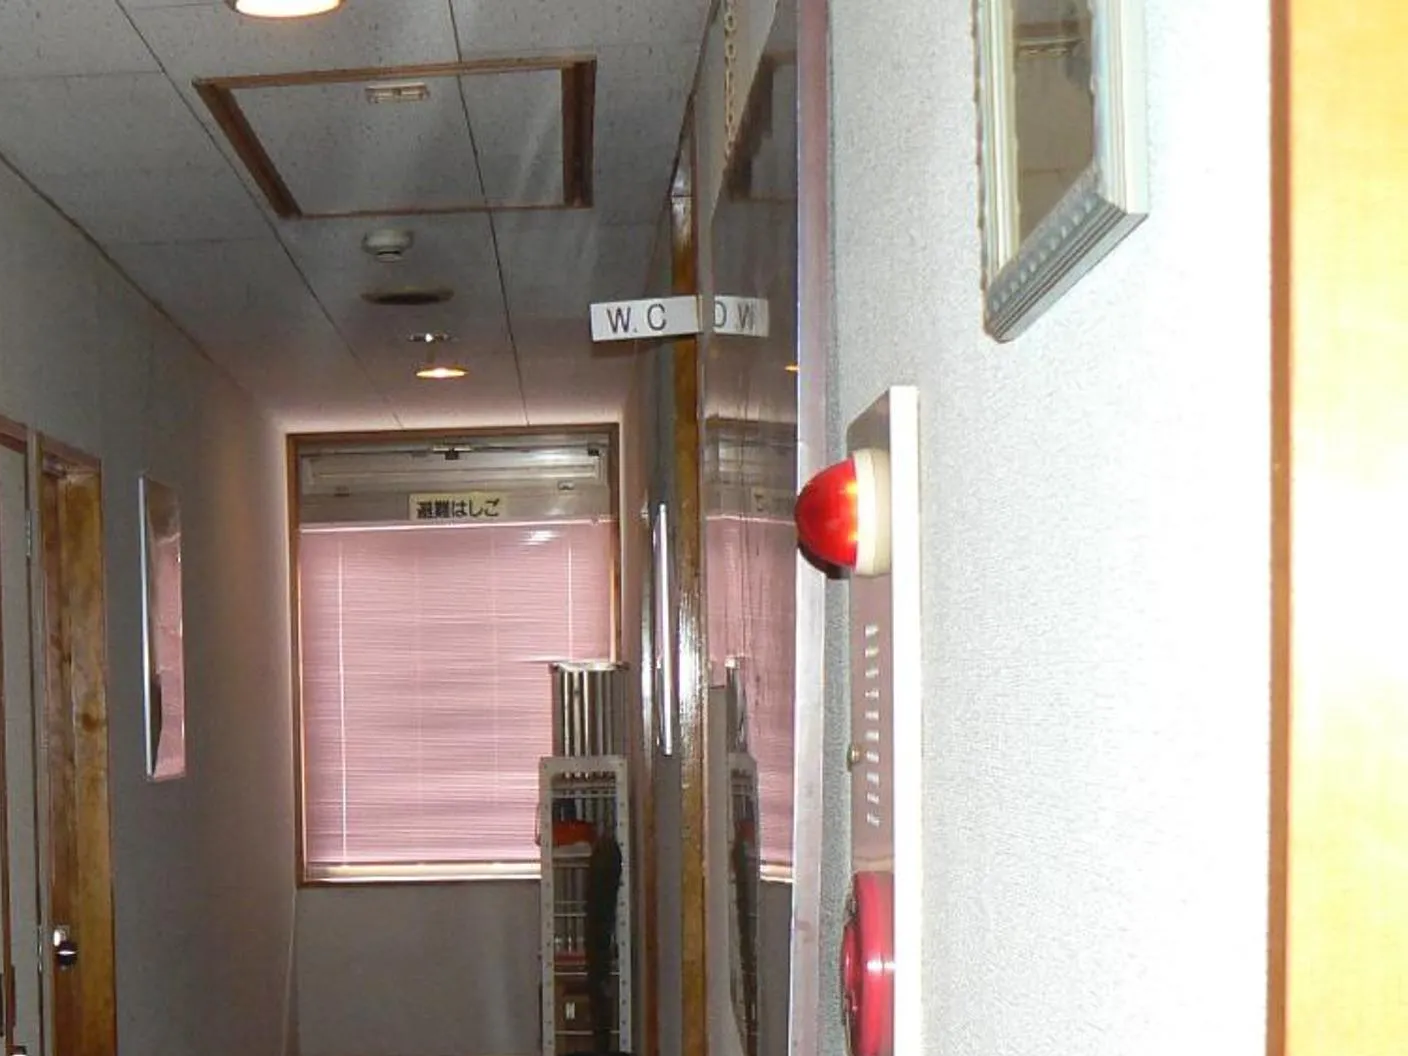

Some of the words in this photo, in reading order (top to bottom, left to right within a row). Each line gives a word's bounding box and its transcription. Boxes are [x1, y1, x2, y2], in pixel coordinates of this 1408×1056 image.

[606, 303, 667, 334] W.C
[416, 498, 501, 519] 避難はしご
